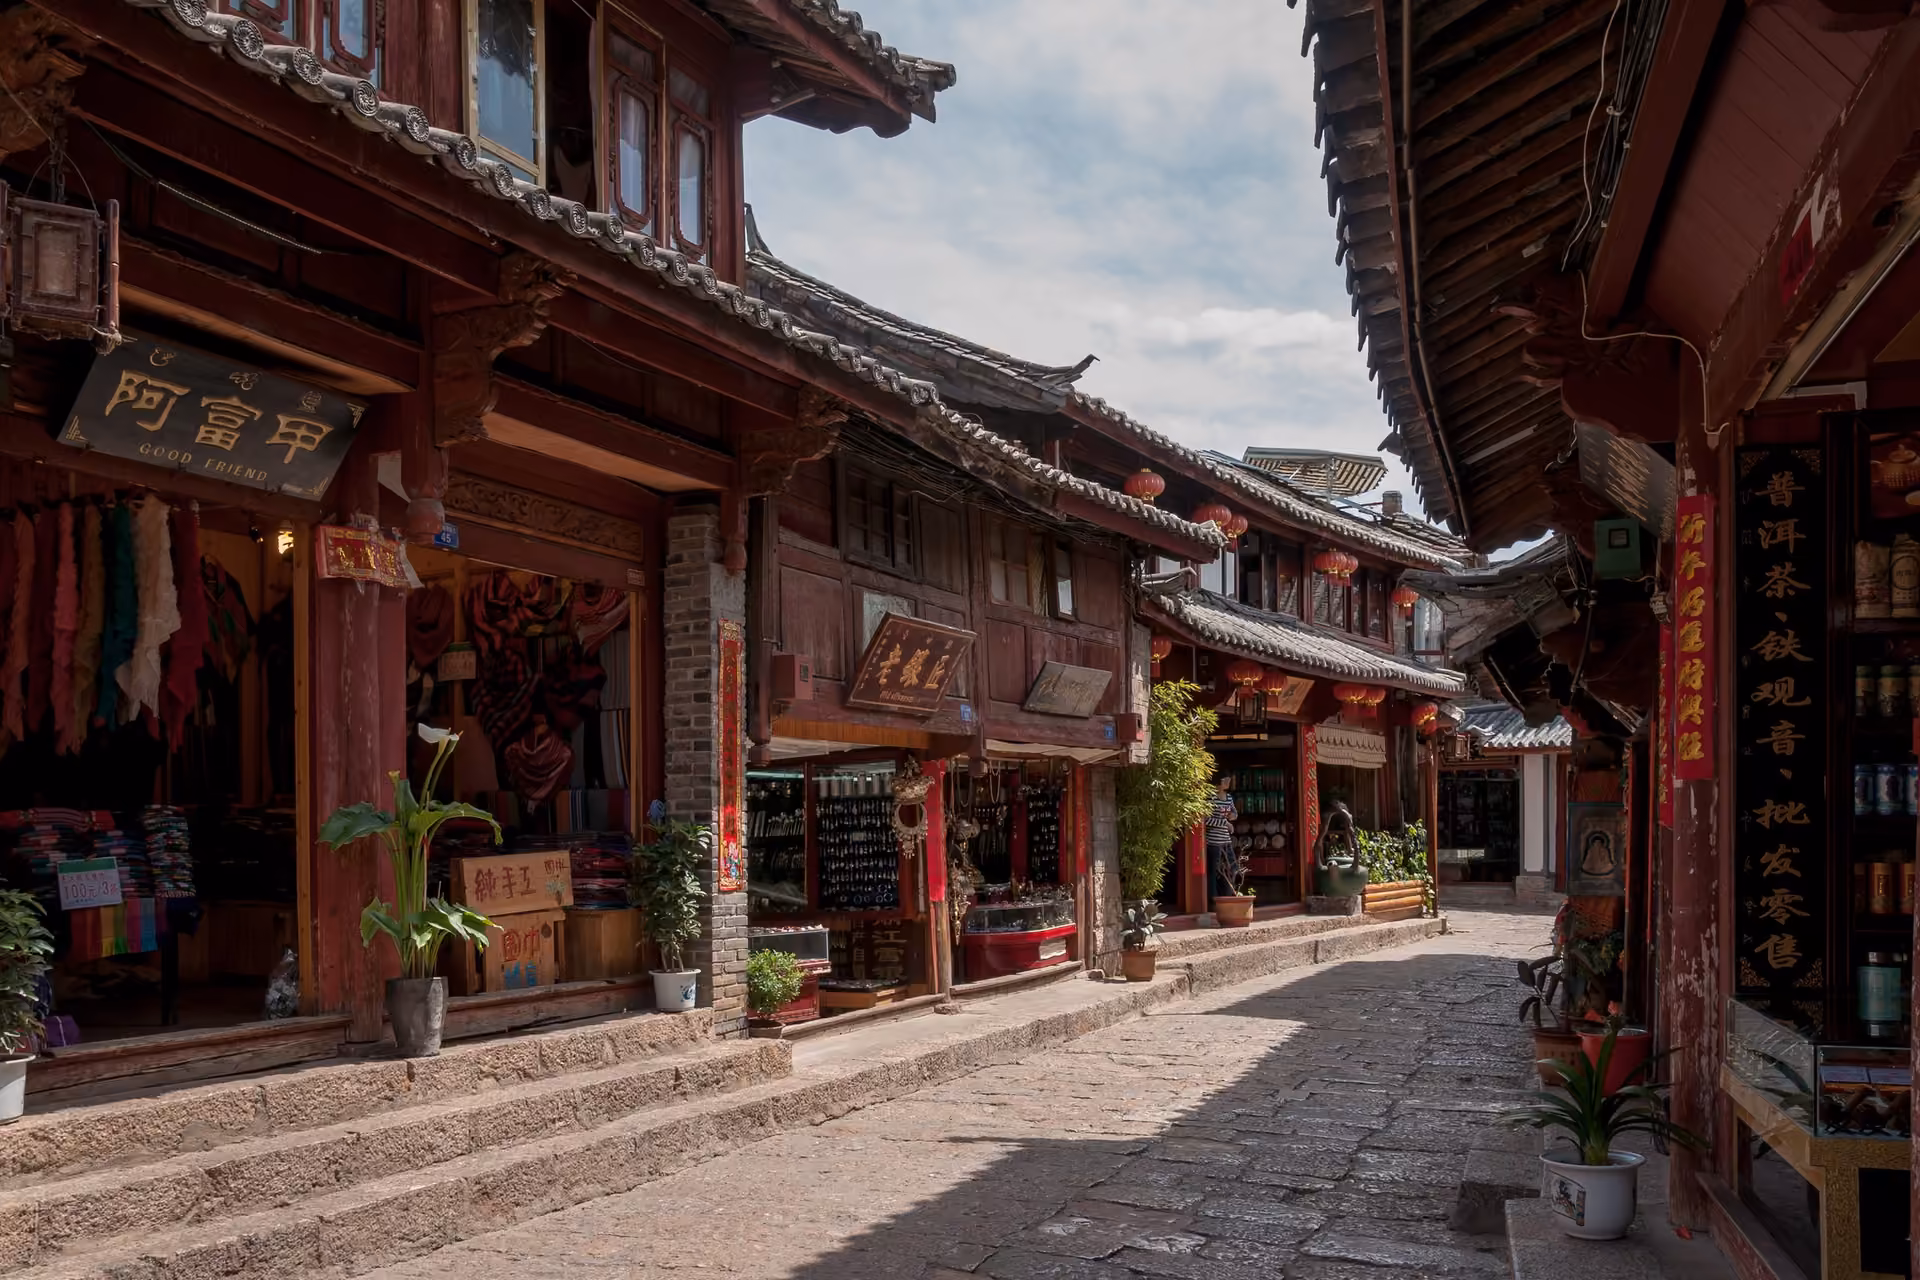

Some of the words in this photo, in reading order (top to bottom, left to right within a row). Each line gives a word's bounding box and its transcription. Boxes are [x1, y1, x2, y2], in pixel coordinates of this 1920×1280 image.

[138, 441, 193, 466] GOOD
[204, 457, 269, 482] FRIEND
[440, 532, 452, 544] 45
